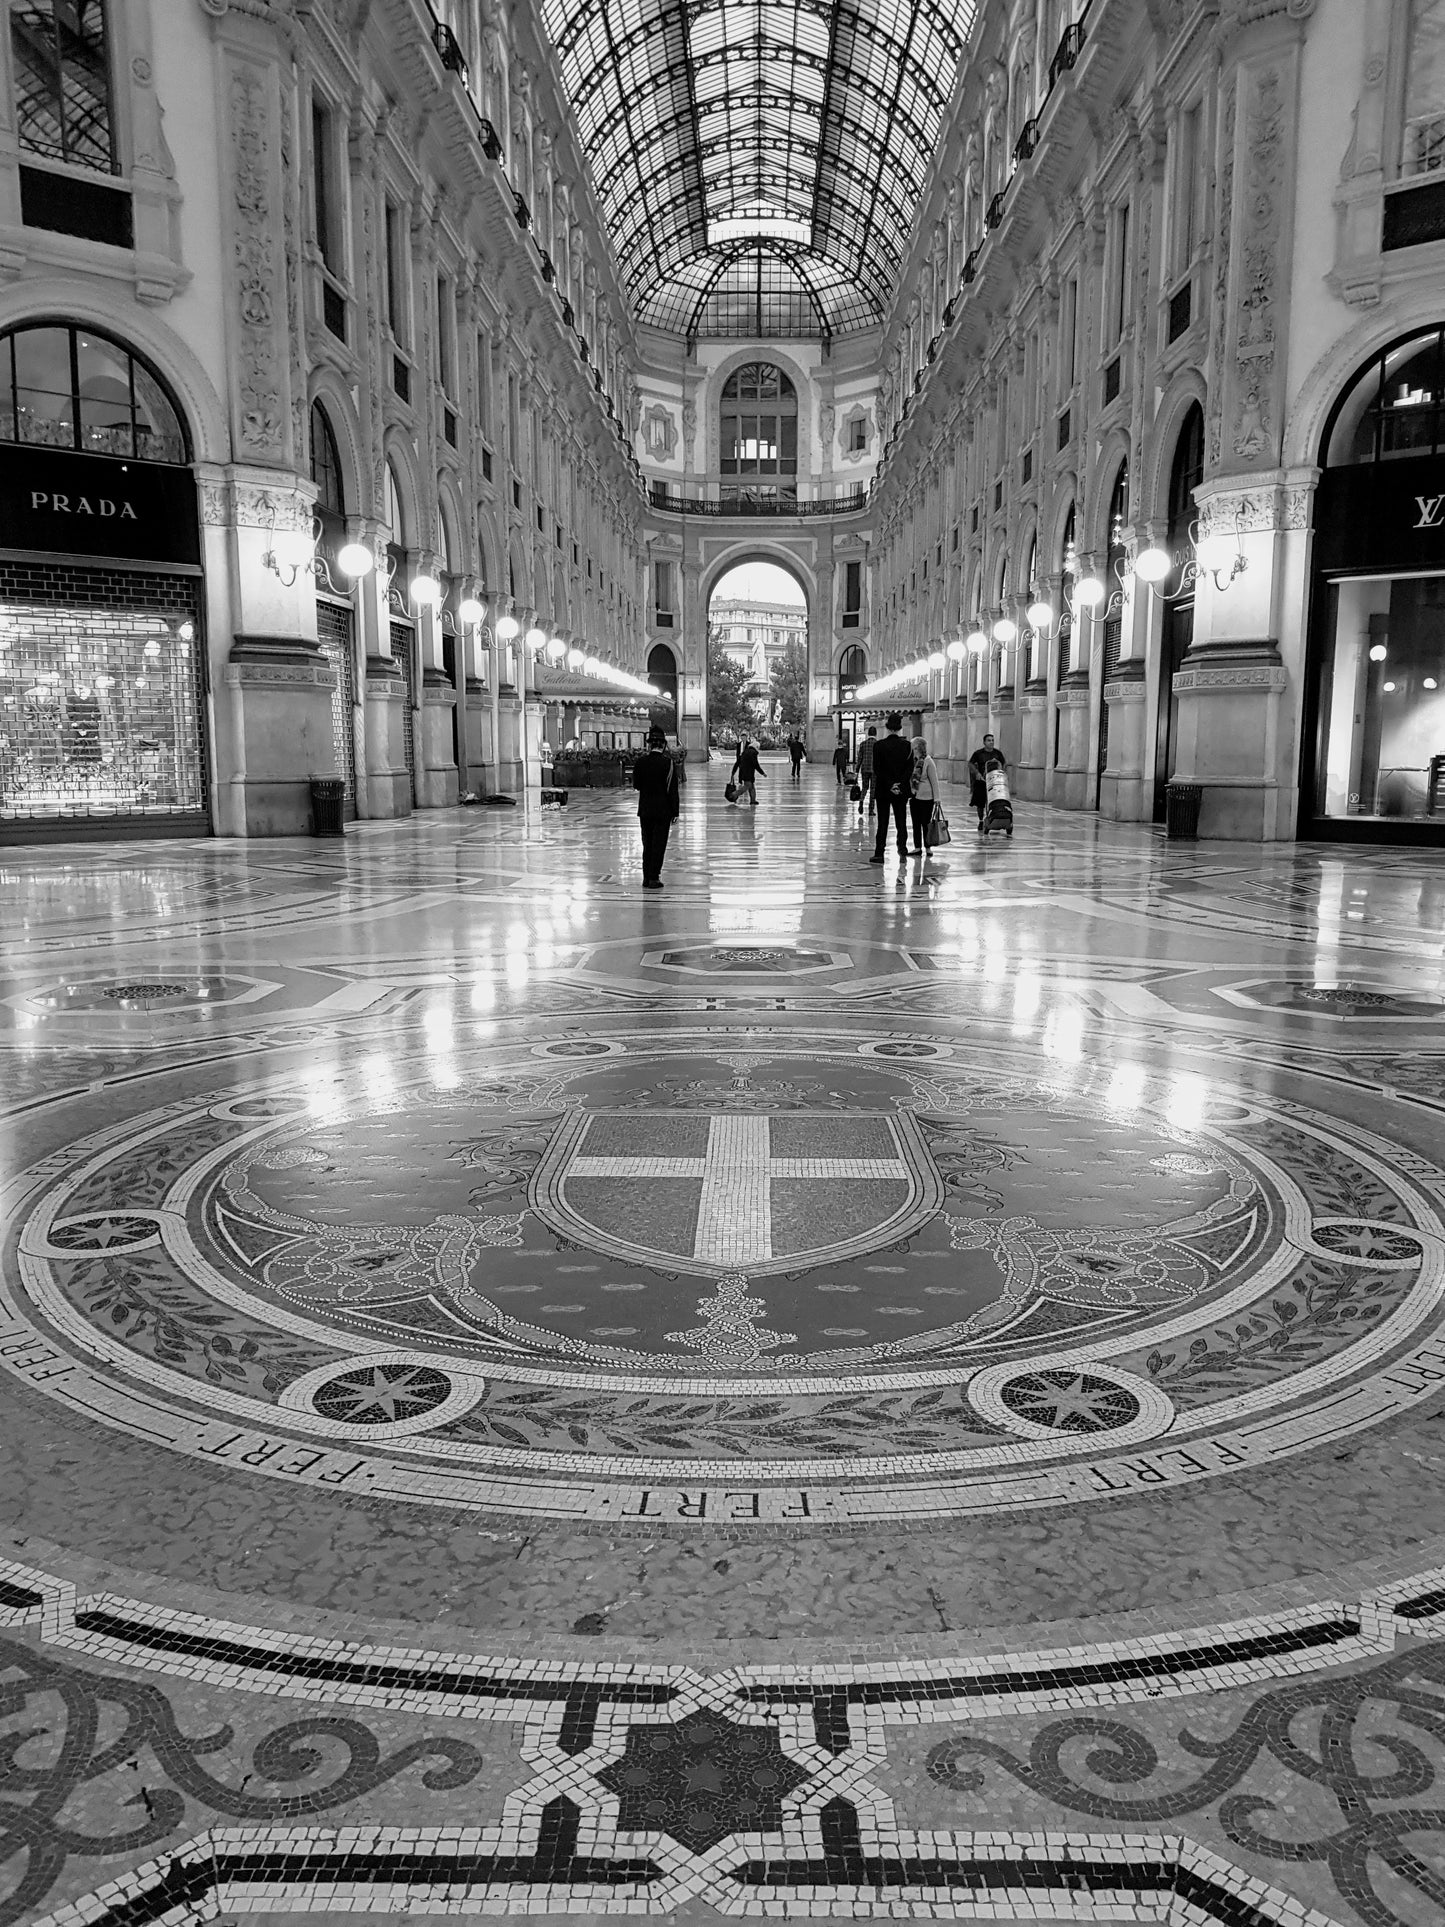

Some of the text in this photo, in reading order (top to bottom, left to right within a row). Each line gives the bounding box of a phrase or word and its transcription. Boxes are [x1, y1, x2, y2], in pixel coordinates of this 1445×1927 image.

[31, 491, 138, 519] PRADA
[24, 1145, 92, 1176] FERT
[198, 1434, 367, 1483] FERT
[1088, 1441, 1247, 1491] FERT
[621, 1491, 810, 1517] FERT
